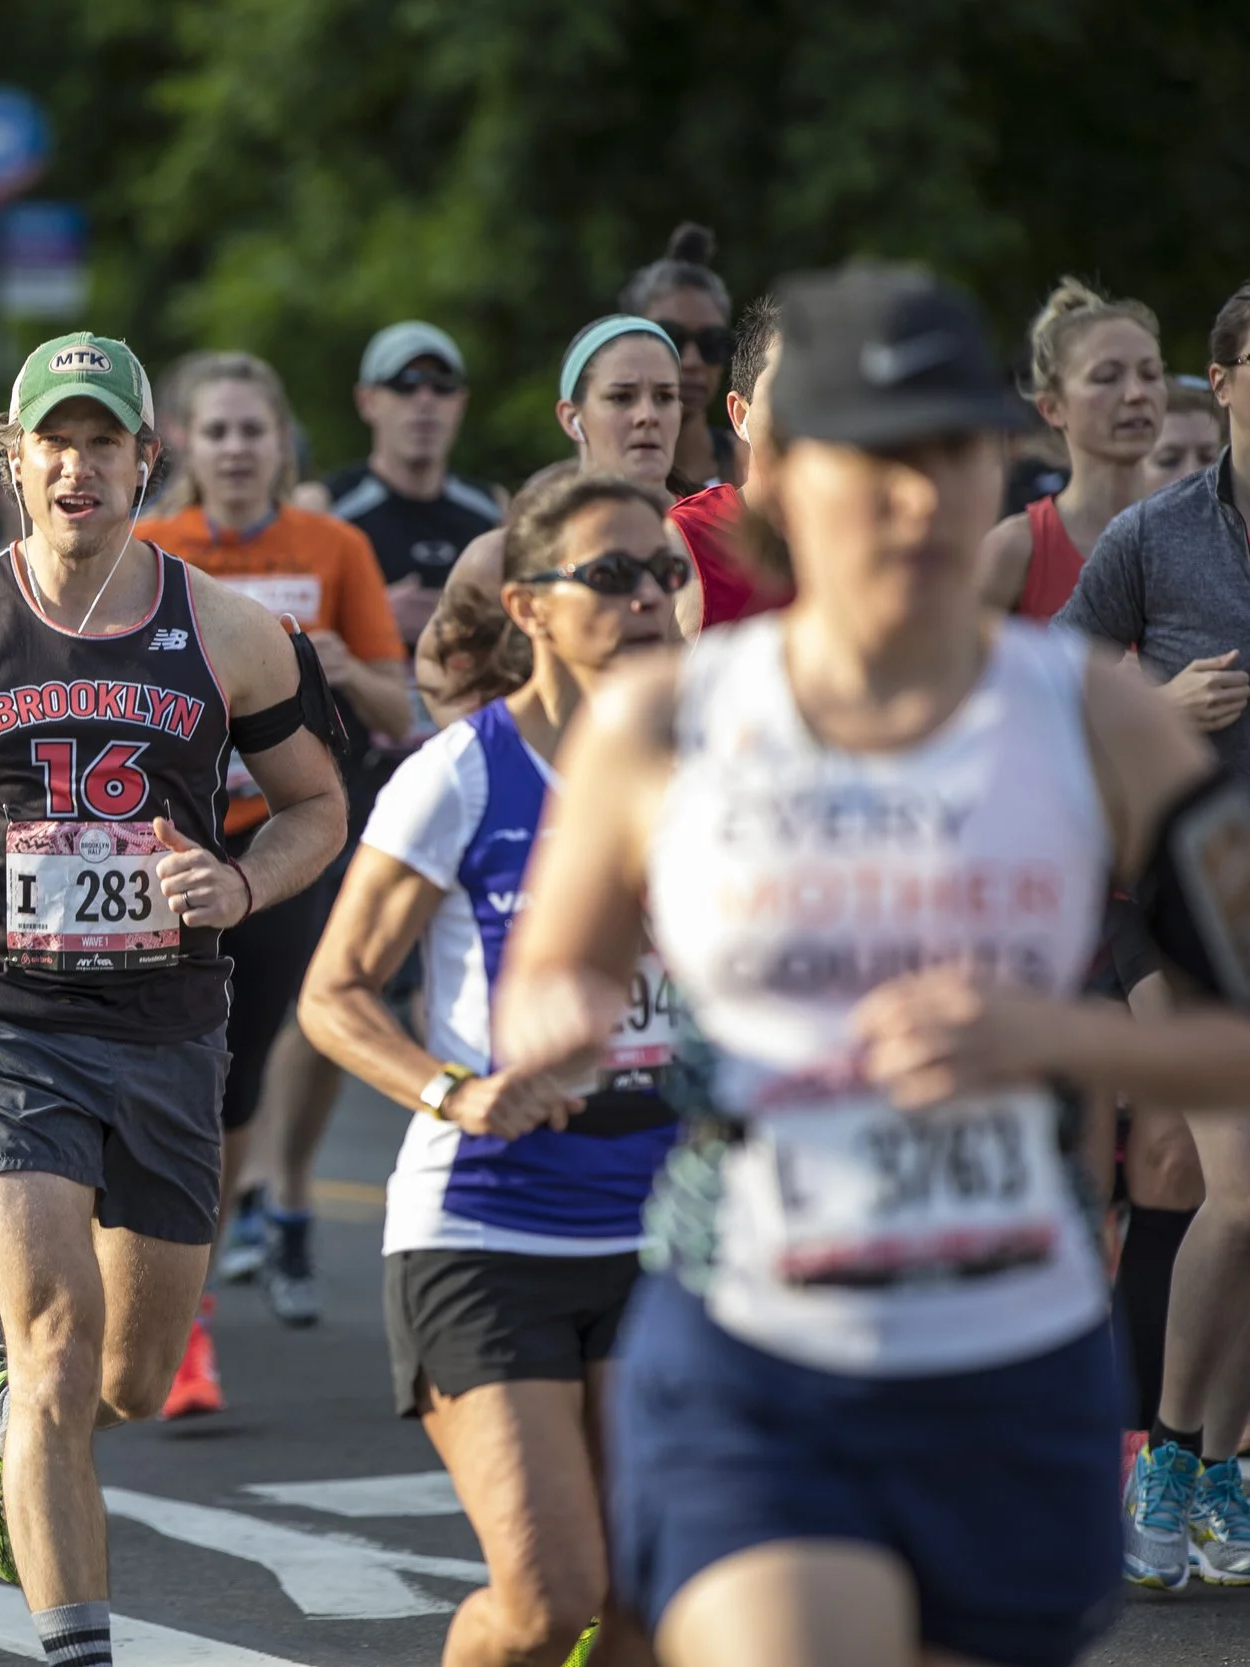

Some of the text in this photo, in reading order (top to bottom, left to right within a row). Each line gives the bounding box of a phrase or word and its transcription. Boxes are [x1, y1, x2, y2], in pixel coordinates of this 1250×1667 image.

[56, 352, 105, 368] MTK
[31, 738, 150, 820] 16
[18, 874, 36, 914] I
[75, 869, 152, 923] 283
[82, 937, 103, 947] WAVE
[611, 969, 686, 1034] 94
